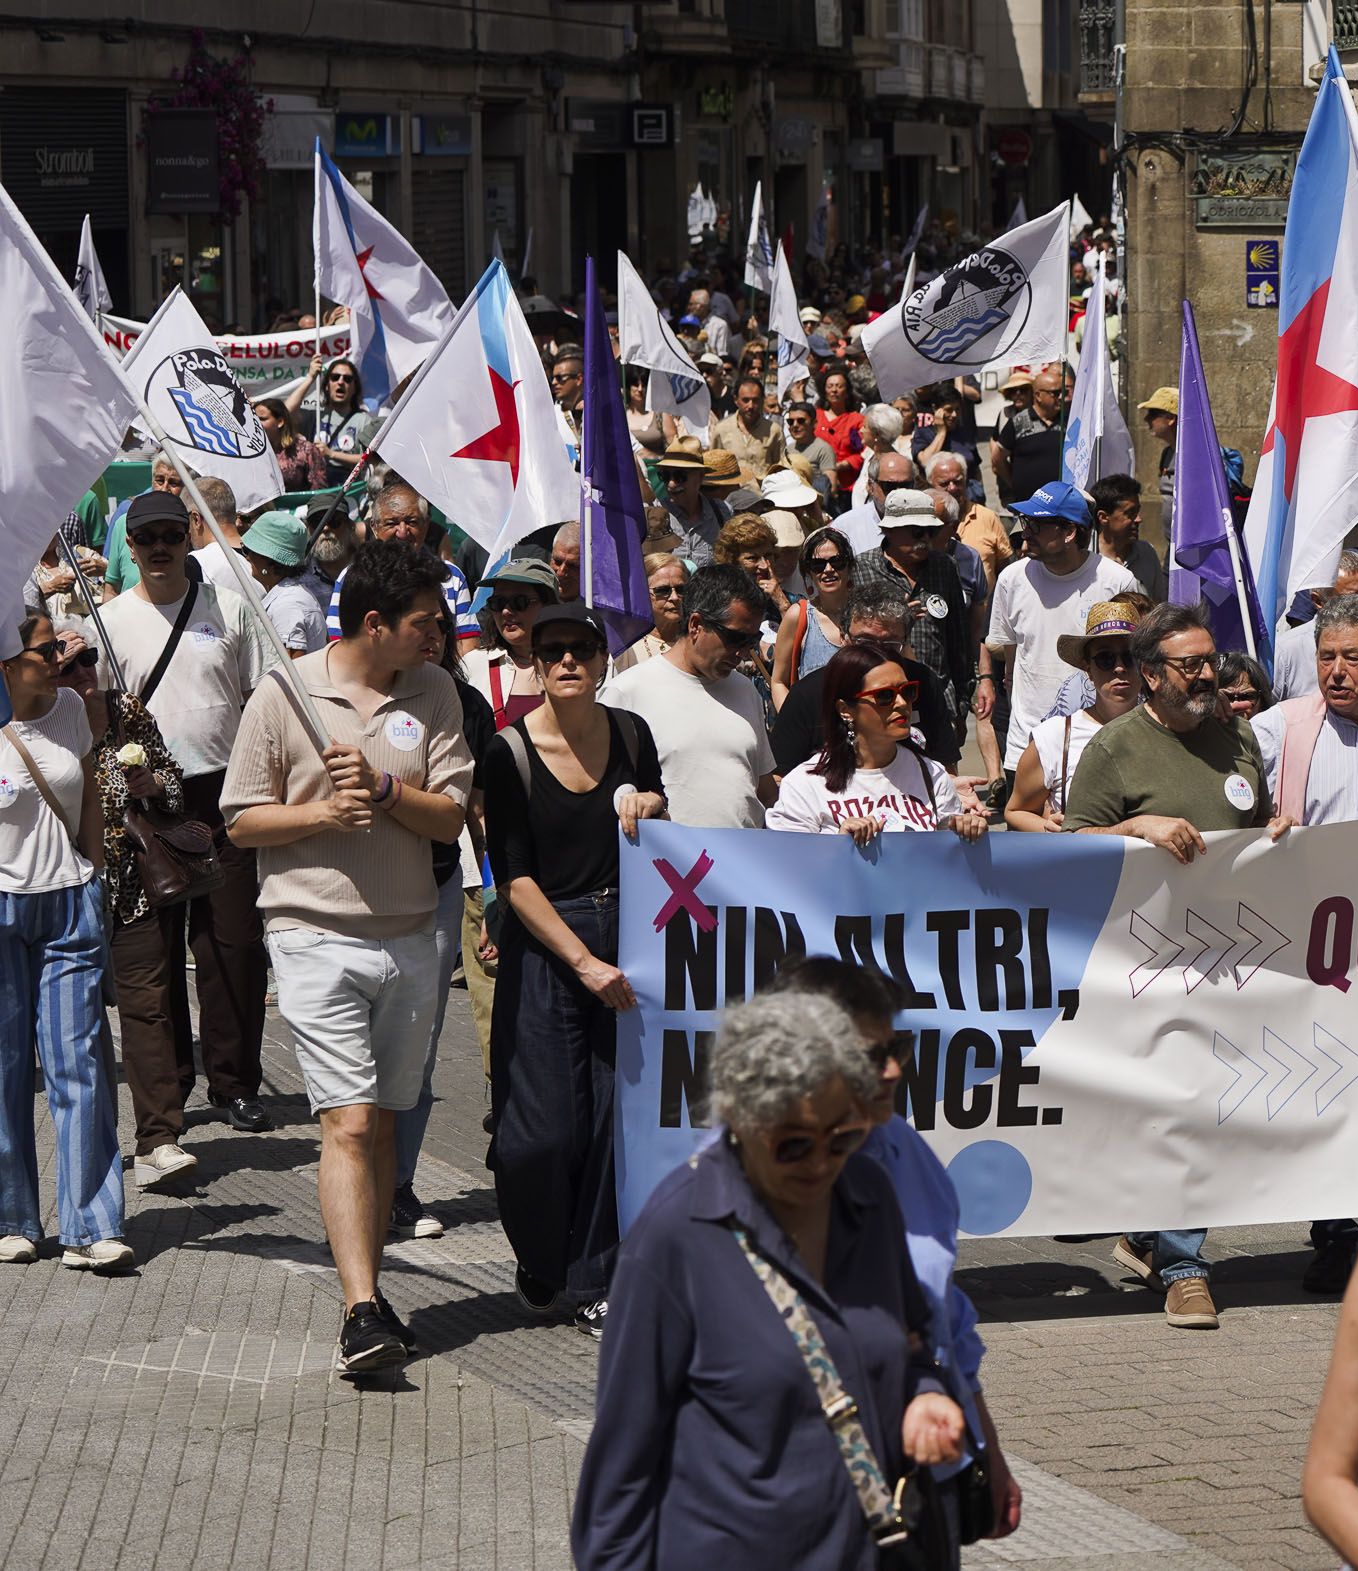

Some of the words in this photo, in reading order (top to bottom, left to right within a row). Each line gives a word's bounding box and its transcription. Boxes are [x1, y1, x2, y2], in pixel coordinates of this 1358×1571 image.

[155, 155, 210, 169] nonna&go
[1208, 206, 1282, 217] ODRIOZOLA
[175, 352, 216, 372] Pola
[273, 367, 300, 380] DA
[393, 725, 419, 740] bng
[1231, 786, 1252, 800] bng
